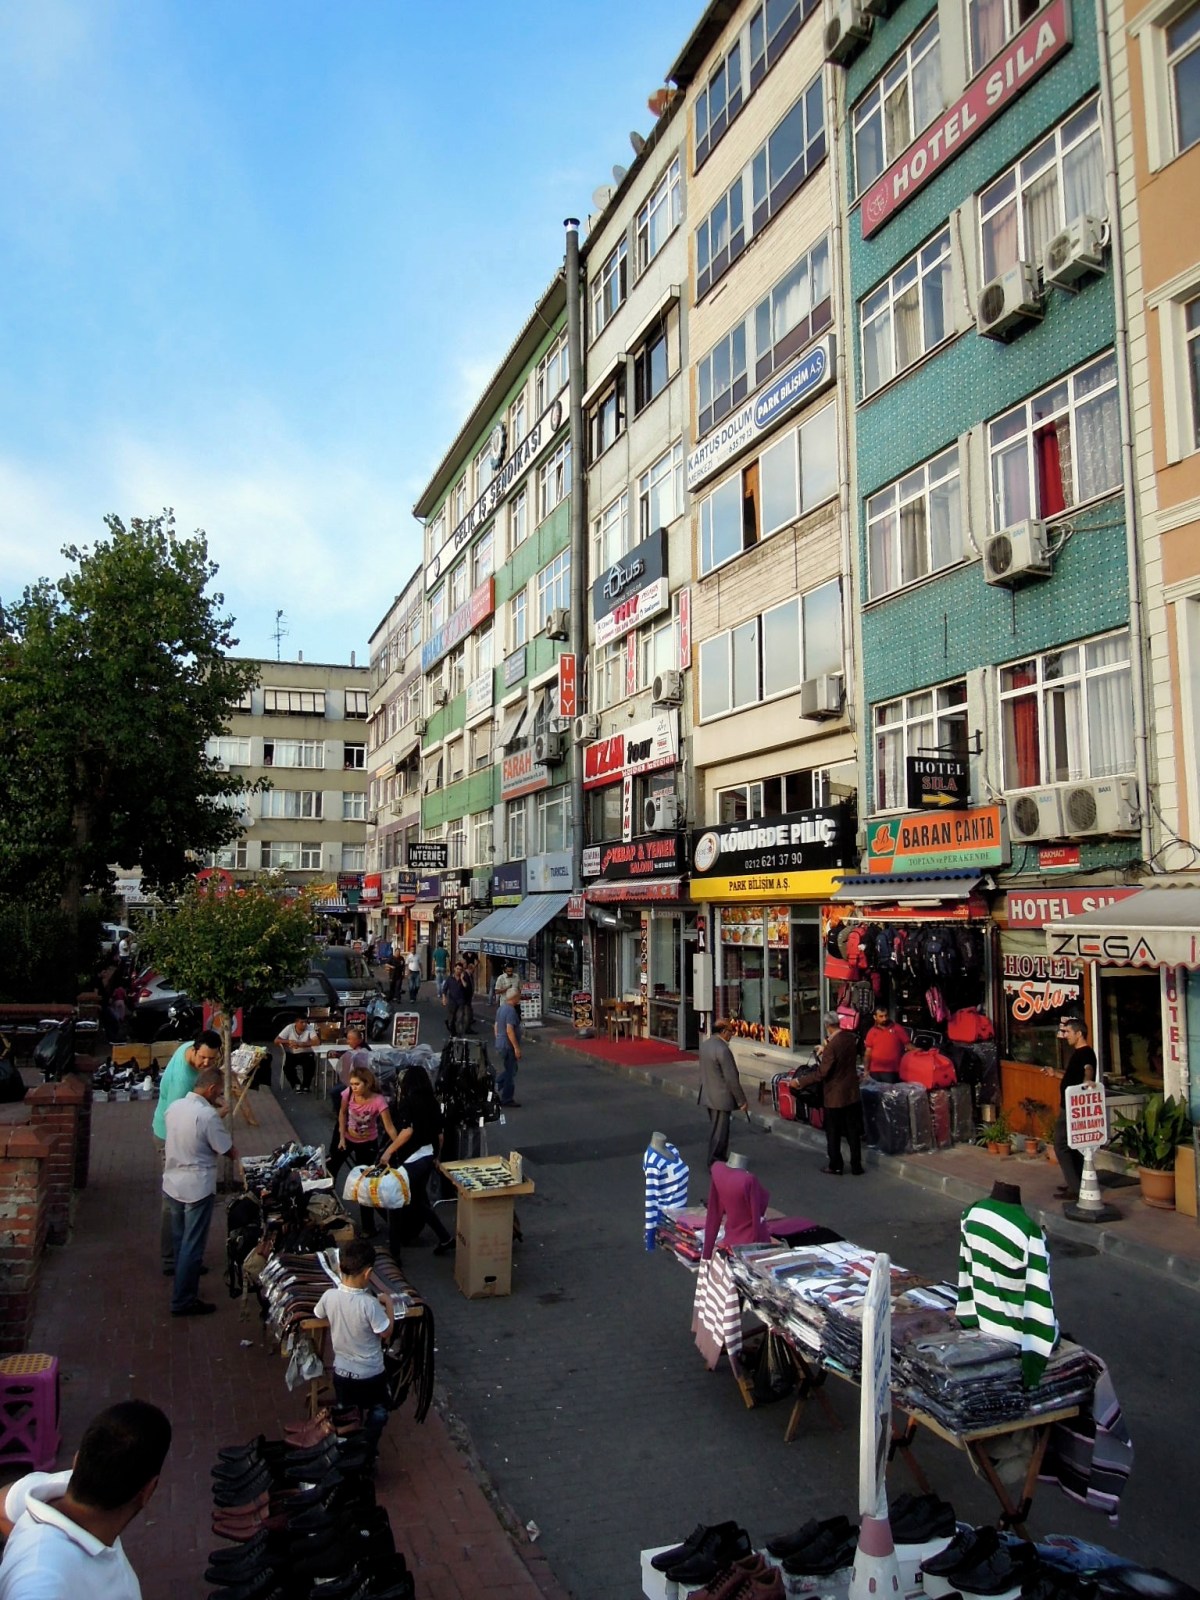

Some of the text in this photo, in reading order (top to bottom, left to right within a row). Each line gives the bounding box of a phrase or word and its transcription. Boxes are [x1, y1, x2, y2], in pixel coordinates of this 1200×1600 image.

[893, 20, 1056, 199] HOTEL SILA
[757, 389, 780, 419] PARK
[721, 406, 752, 445] DOLUM
[611, 594, 640, 625] THY
[562, 657, 574, 713] THY
[627, 737, 653, 764] tour
[503, 750, 532, 781] FARAH
[914, 761, 964, 776] HOTEL
[922, 776, 958, 791] SILA
[720, 814, 836, 853] KÖMÜRDE PİLİÇ
[903, 816, 994, 849] BARAN ÇANTA
[612, 845, 636, 863] KEBAP
[637, 843, 645, 860] &
[645, 839, 676, 859] YEMEK
[745, 852, 802, 869] 0212 621 37 90
[943, 852, 991, 864] PERAKENDE
[729, 880, 747, 891] PARK
[748, 876, 775, 892] BİLİŞİM
[443, 898, 458, 909] CAFE
[1011, 898, 1075, 920] HOTEL
[1051, 934, 1157, 961] ZEGA
[1004, 955, 1079, 980] HOTEL
[1166, 967, 1180, 1062] HOTEL
[1071, 1092, 1103, 1106] HOTEL
[1071, 1105, 1104, 1118] SILA
